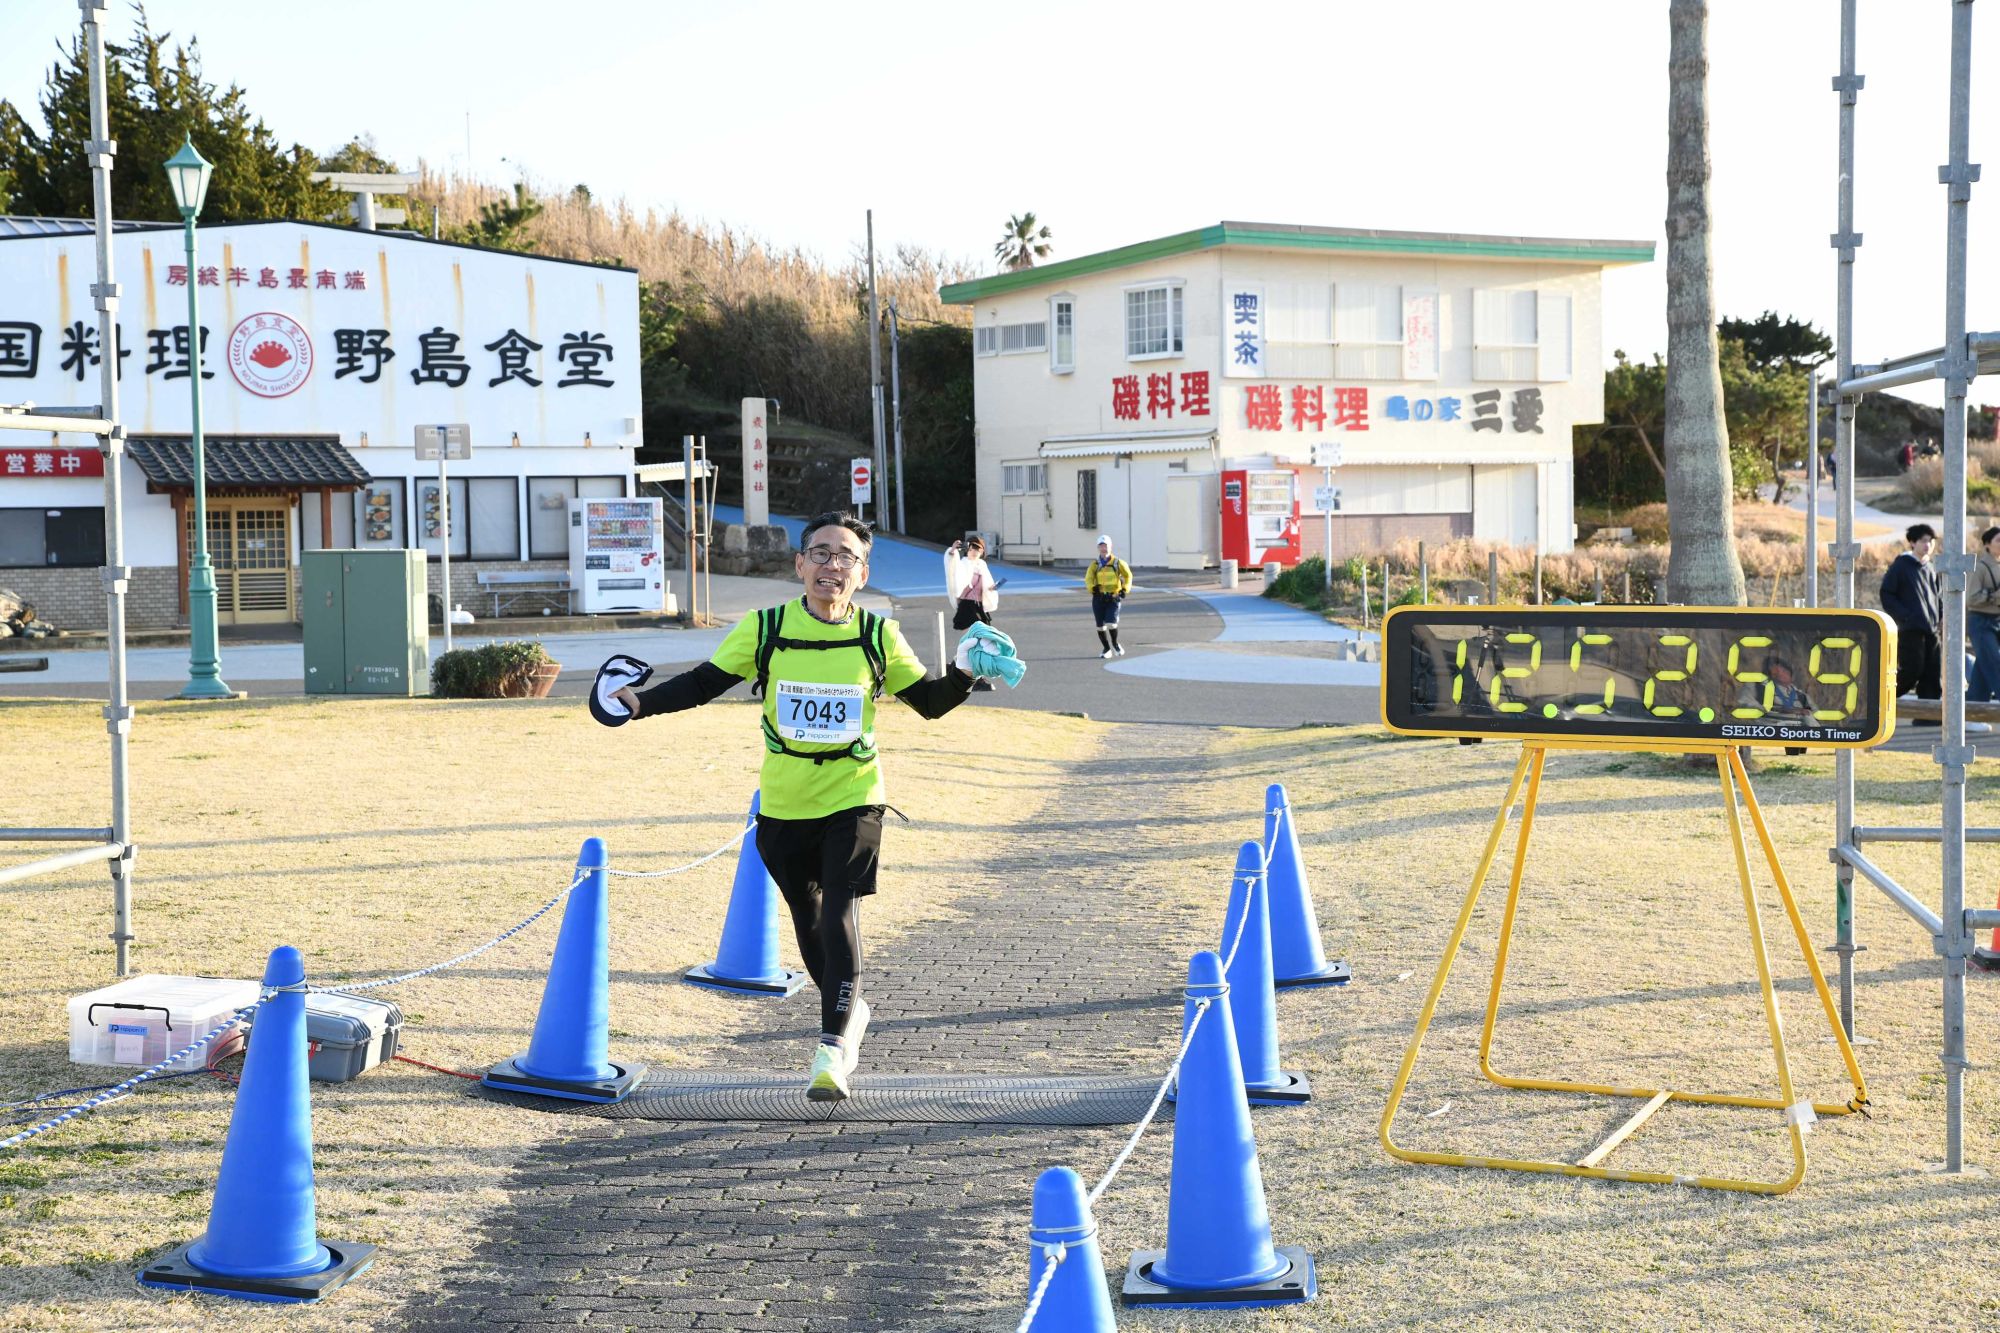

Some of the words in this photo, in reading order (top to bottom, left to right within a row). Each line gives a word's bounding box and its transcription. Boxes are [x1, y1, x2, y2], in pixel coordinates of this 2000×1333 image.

[165, 264, 368, 291] 房総半島最南端
[238, 316, 300, 339] 野島食堂
[1233, 291, 1259, 365] 喫茶
[332, 325, 616, 389] 野島食堂
[1111, 370, 1211, 421] 磯料理
[1243, 384, 1370, 432] 磯料理
[4, 452, 81, 474] 営業中
[790, 698, 847, 723] 7043
[1721, 724, 1776, 737] SEIKO
[1779, 727, 1821, 740] Sports
[1824, 728, 1862, 740] Timer
